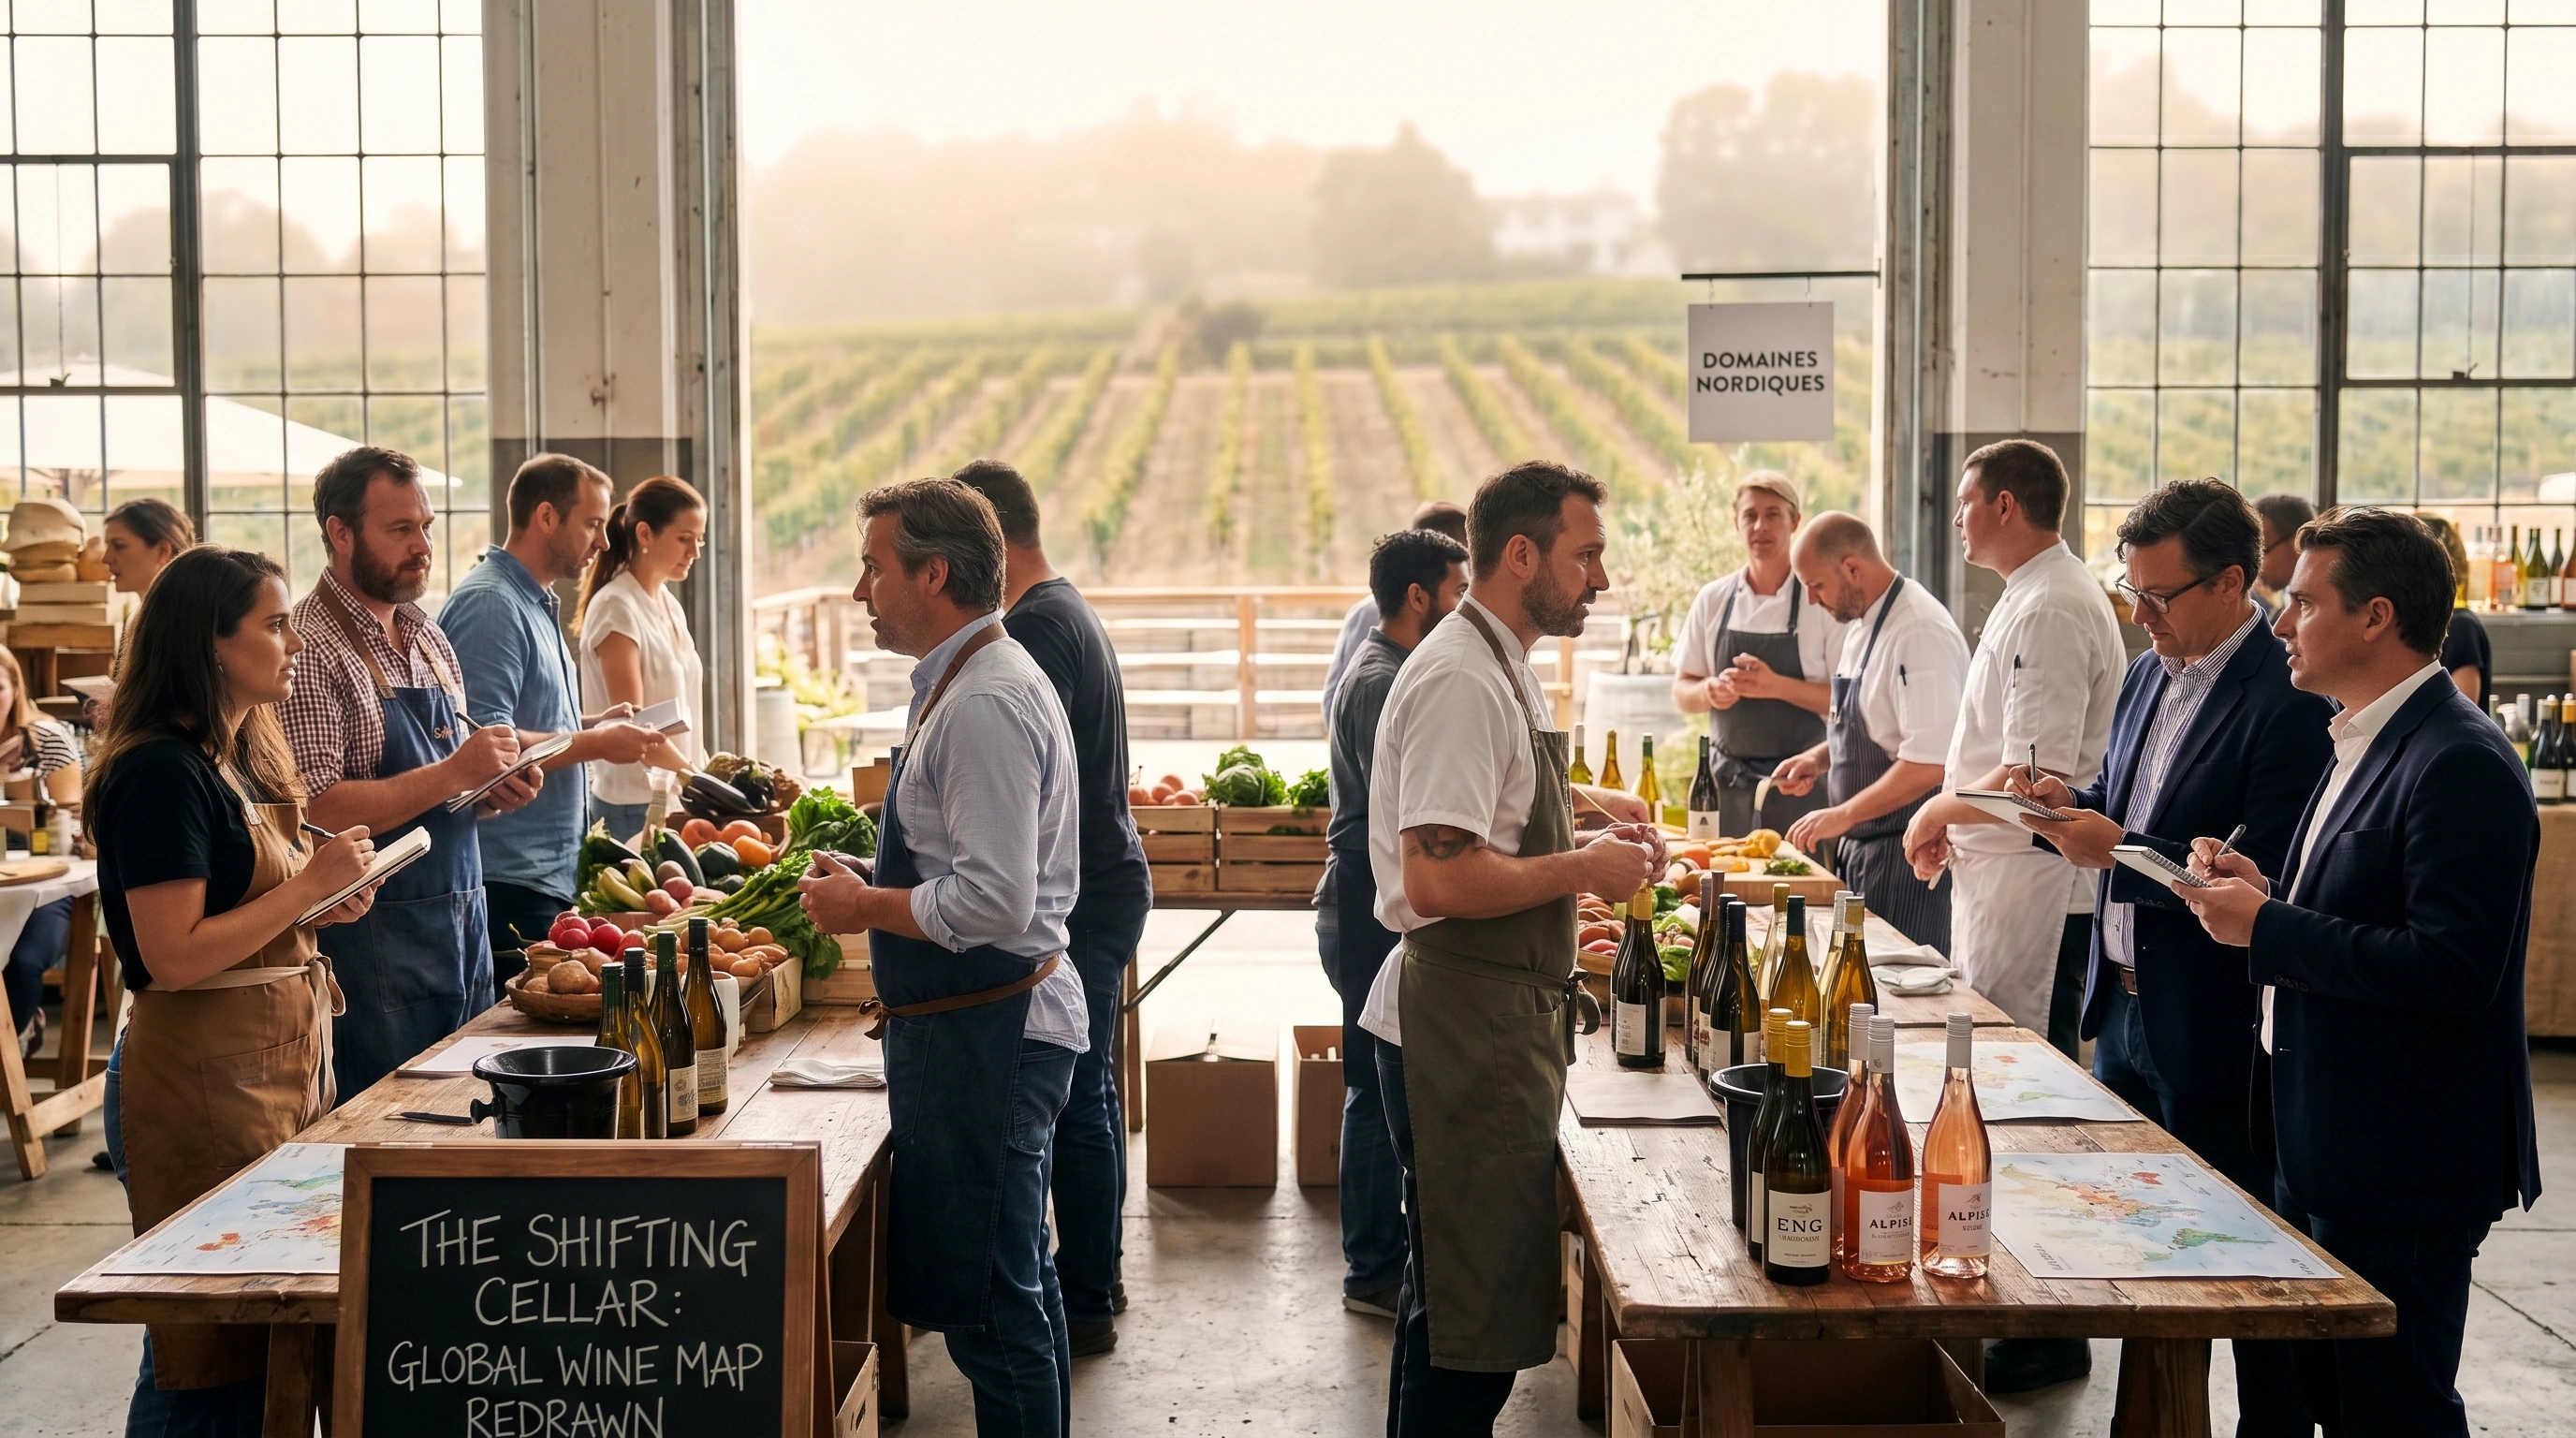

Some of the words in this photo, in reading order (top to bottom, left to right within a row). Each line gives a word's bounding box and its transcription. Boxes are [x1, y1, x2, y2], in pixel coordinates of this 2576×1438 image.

[1703, 351, 1818, 369] DOMAINES
[1696, 374, 1824, 396] NORDIQUES
[401, 1209, 502, 1268] THE
[527, 1213, 757, 1278] SHIFTING
[1777, 1217, 1822, 1233] ENG
[475, 1276, 681, 1328] CELLAR:
[388, 1341, 544, 1392] GLOBAL
[556, 1343, 659, 1387] WINE
[676, 1341, 763, 1392] MAP
[466, 1396, 664, 1438] REDRAWN
